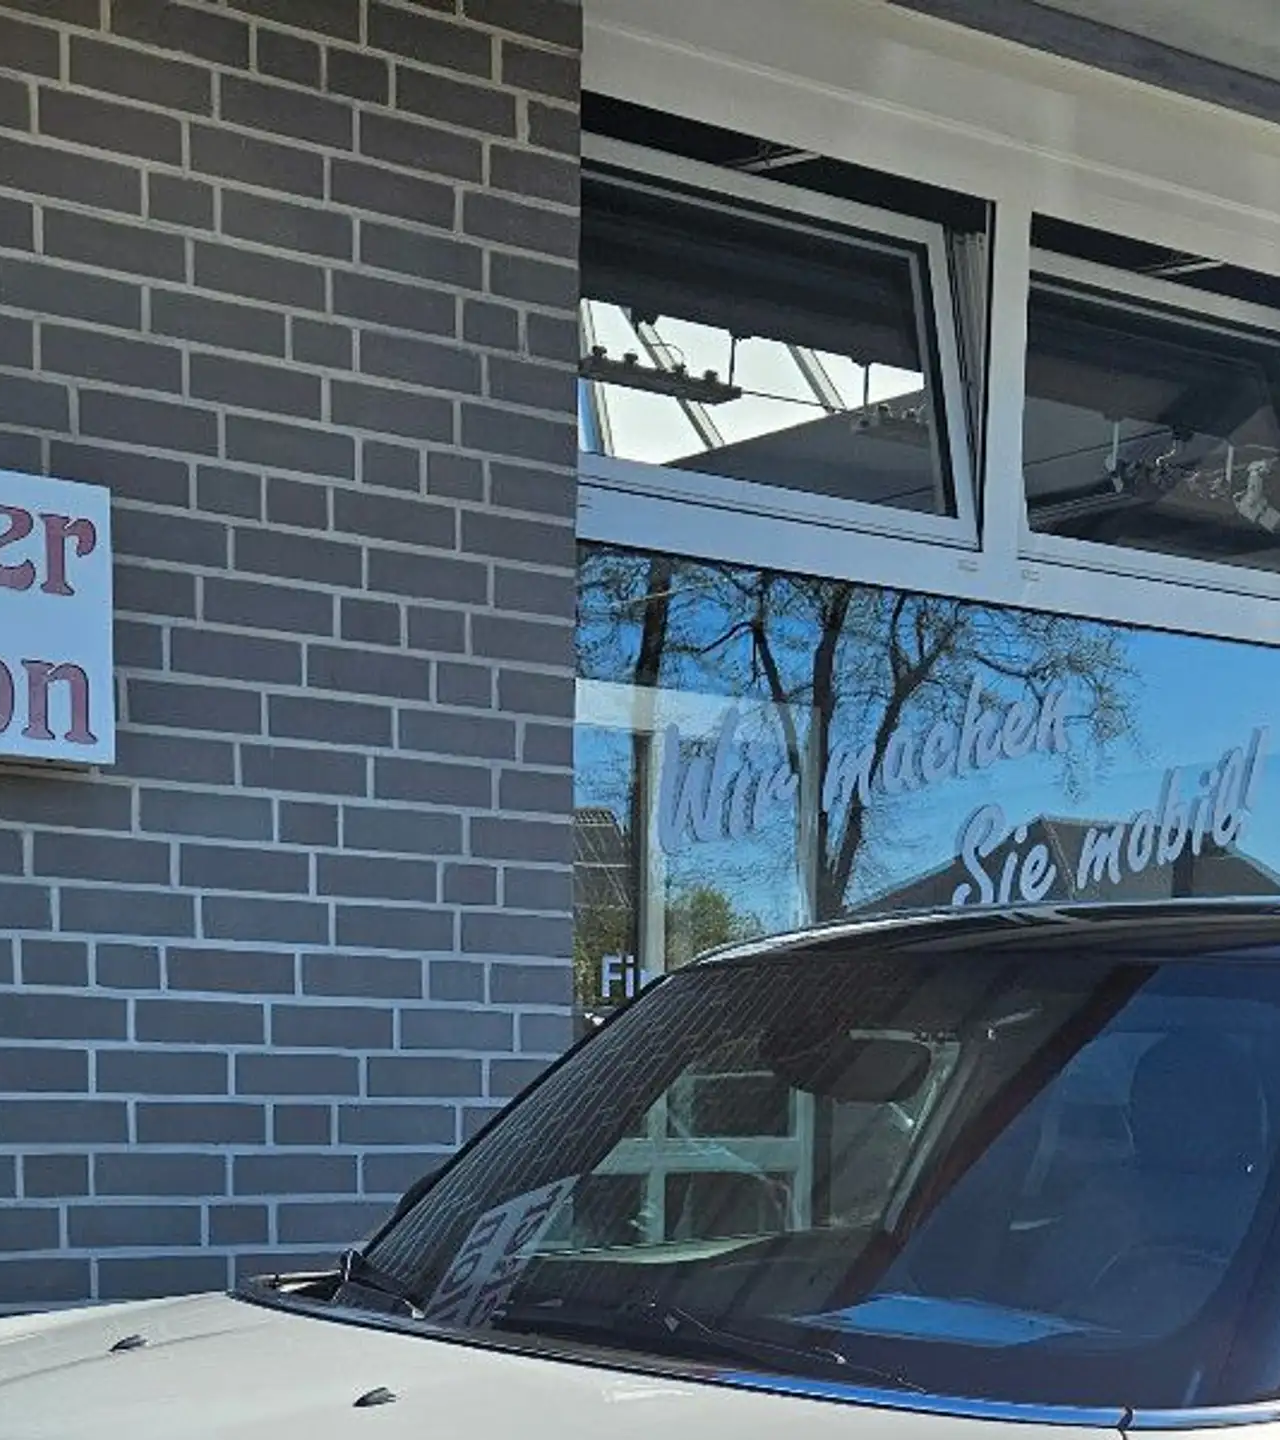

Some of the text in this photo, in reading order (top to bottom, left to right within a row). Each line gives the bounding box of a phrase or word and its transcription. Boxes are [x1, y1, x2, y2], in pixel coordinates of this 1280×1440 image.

[658, 672, 1072, 855] Wir machen
[952, 802, 1057, 904] Sie
